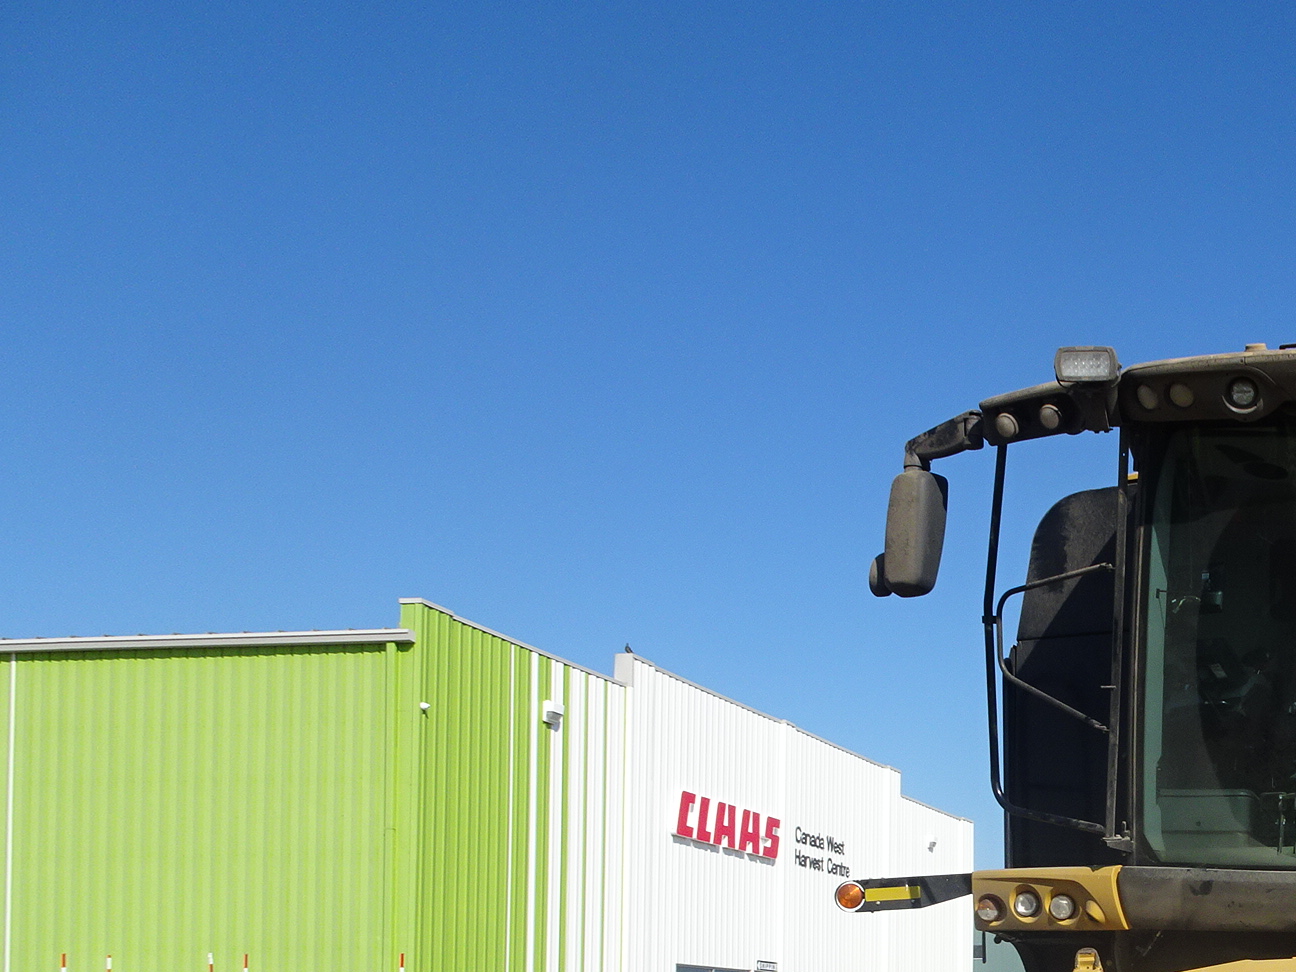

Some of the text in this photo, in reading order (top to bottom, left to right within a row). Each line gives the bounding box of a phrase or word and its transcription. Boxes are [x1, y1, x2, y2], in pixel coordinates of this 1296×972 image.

[676, 790, 781, 859] CLAAS
[795, 826, 845, 856] Canada West
[794, 848, 850, 878] Harvest Centre
